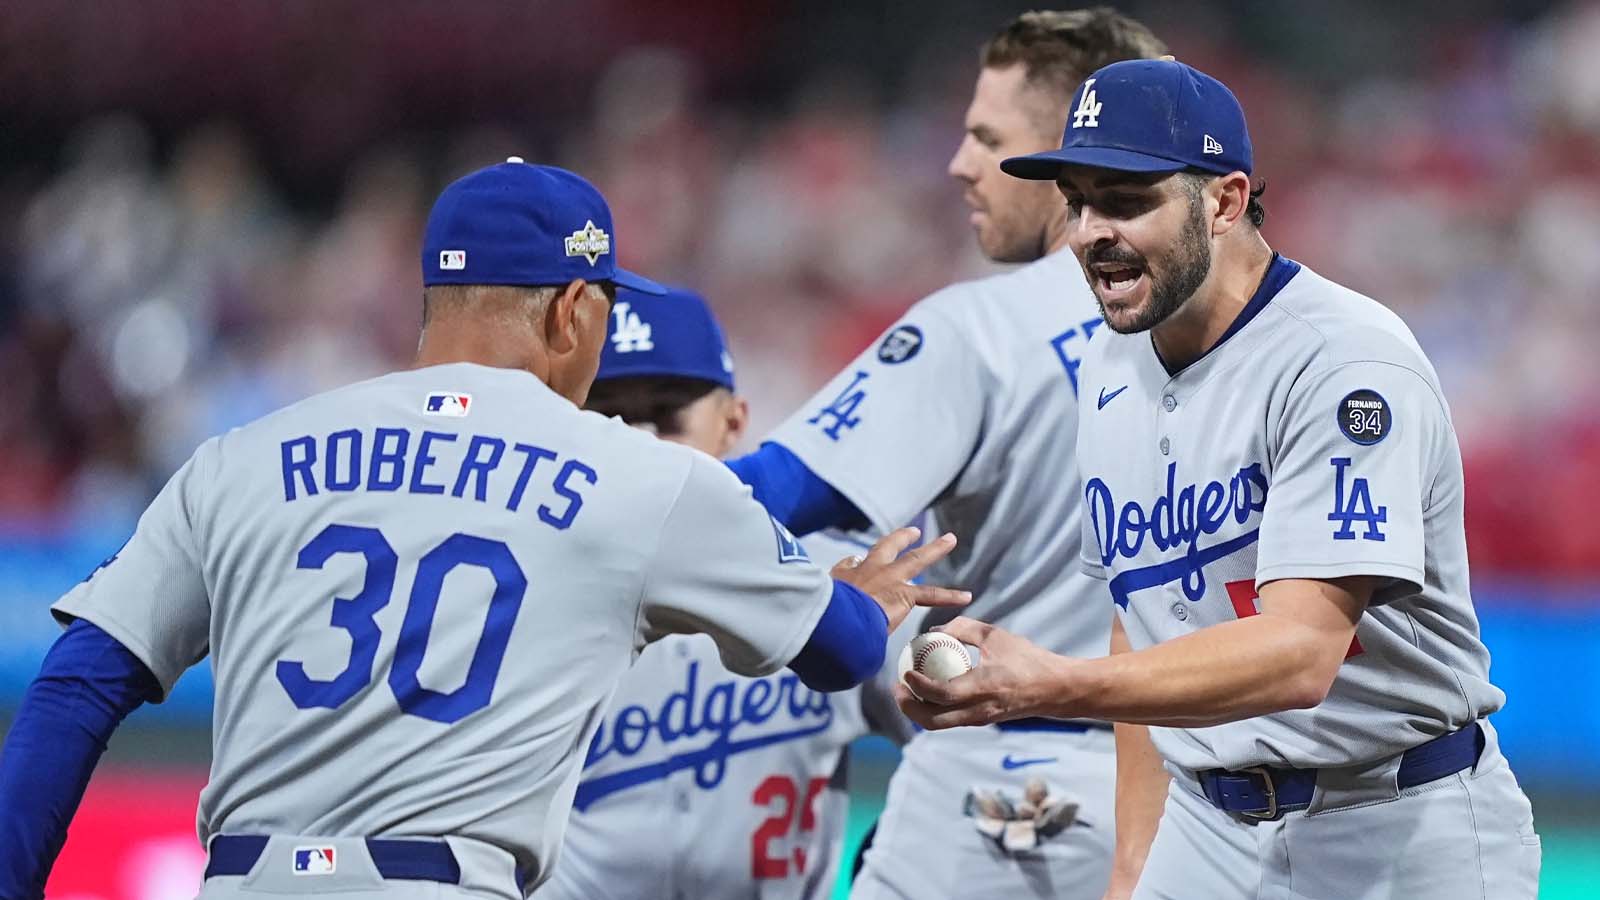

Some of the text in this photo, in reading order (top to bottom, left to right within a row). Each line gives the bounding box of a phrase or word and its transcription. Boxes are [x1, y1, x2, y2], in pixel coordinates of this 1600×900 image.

[1072, 78, 1103, 129] LA
[611, 301, 655, 353] LA
[806, 370, 871, 441] LA
[1347, 399, 1383, 410] FERNANDO
[1349, 409, 1382, 435] 34
[280, 427, 598, 530] ROBERTS
[1327, 457, 1388, 542] LA
[1085, 461, 1269, 601] Dodgers
[275, 523, 528, 725] 30
[583, 660, 833, 789] odgers
